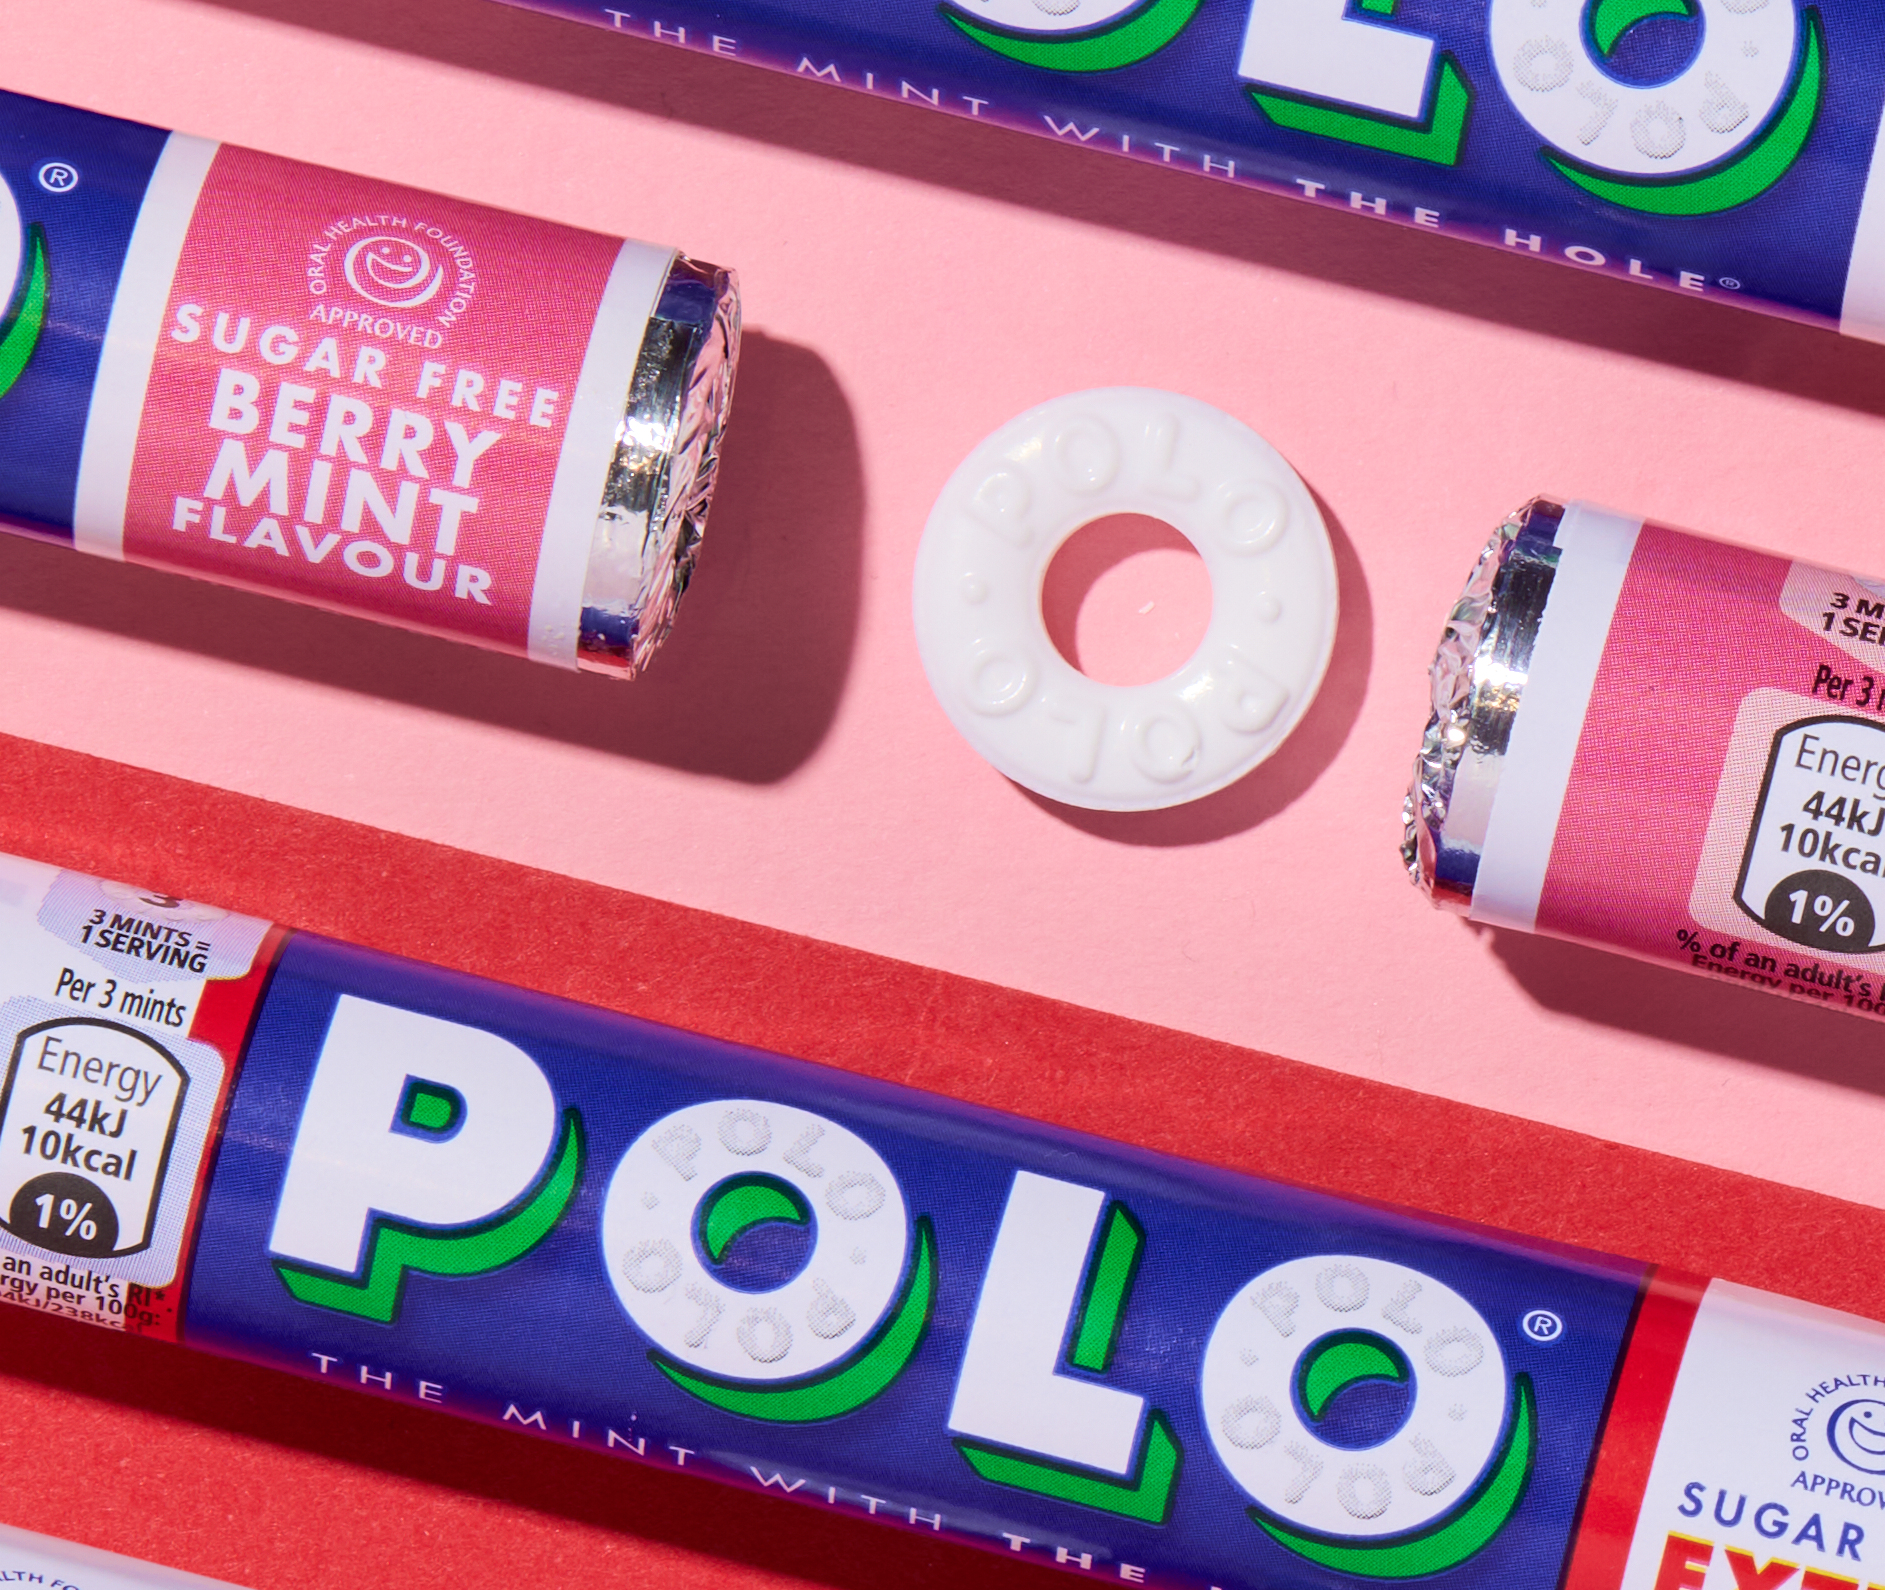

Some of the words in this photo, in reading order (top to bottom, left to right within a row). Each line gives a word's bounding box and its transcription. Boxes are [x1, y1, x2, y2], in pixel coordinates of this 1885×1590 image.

[602, 8, 741, 58] THE
[796, 56, 990, 119] MINT
[1044, 115, 1236, 178] WITH
[1295, 177, 1440, 228] THE
[306, 243, 332, 296] ORAL
[323, 214, 408, 241] HEALTH
[414, 222, 476, 329] FOUNDATION
[309, 304, 444, 349] APPROVED
[171, 303, 387, 388] SUGAR
[416, 361, 559, 428] FREE
[209, 367, 502, 489] BERRY
[203, 438, 480, 556] MINT
[173, 496, 493, 604] FLAVOUR
[1812, 663, 1854, 700] Per
[1855, 675, 1875, 707] 3
[1789, 889, 1855, 937] 1%
[37, 1036, 162, 1107] Energy
[44, 1093, 127, 1139] 44kJ
[22, 1125, 138, 1181] 10kcal
[35, 1193, 97, 1240] 1%
[1790, 1408, 1814, 1462] ORAL
[1678, 1481, 1865, 1562] SUGAR
